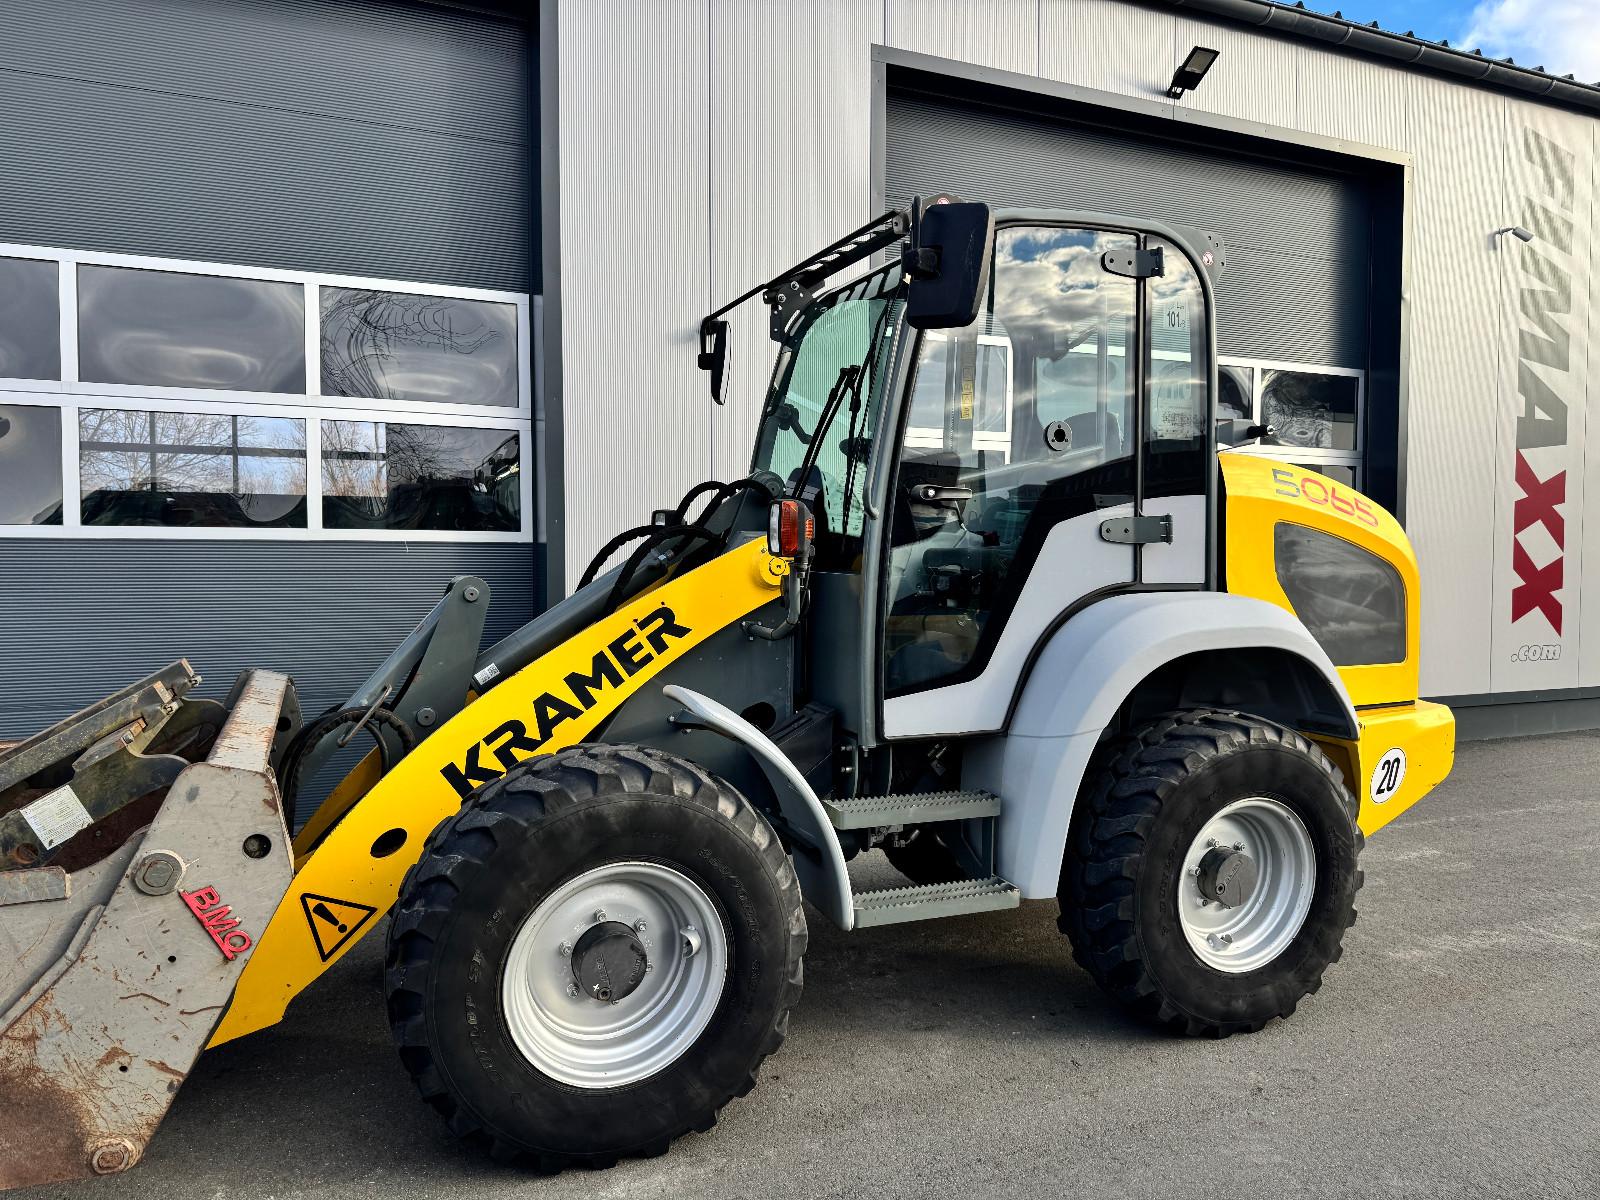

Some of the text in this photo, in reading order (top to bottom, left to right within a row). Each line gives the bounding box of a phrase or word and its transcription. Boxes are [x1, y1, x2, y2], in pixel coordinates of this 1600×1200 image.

[1511, 126, 1576, 637] FIMAXX
[1272, 468, 1378, 528] 5065
[440, 606, 693, 798] KRAMER
[1376, 757, 1401, 795] 20
